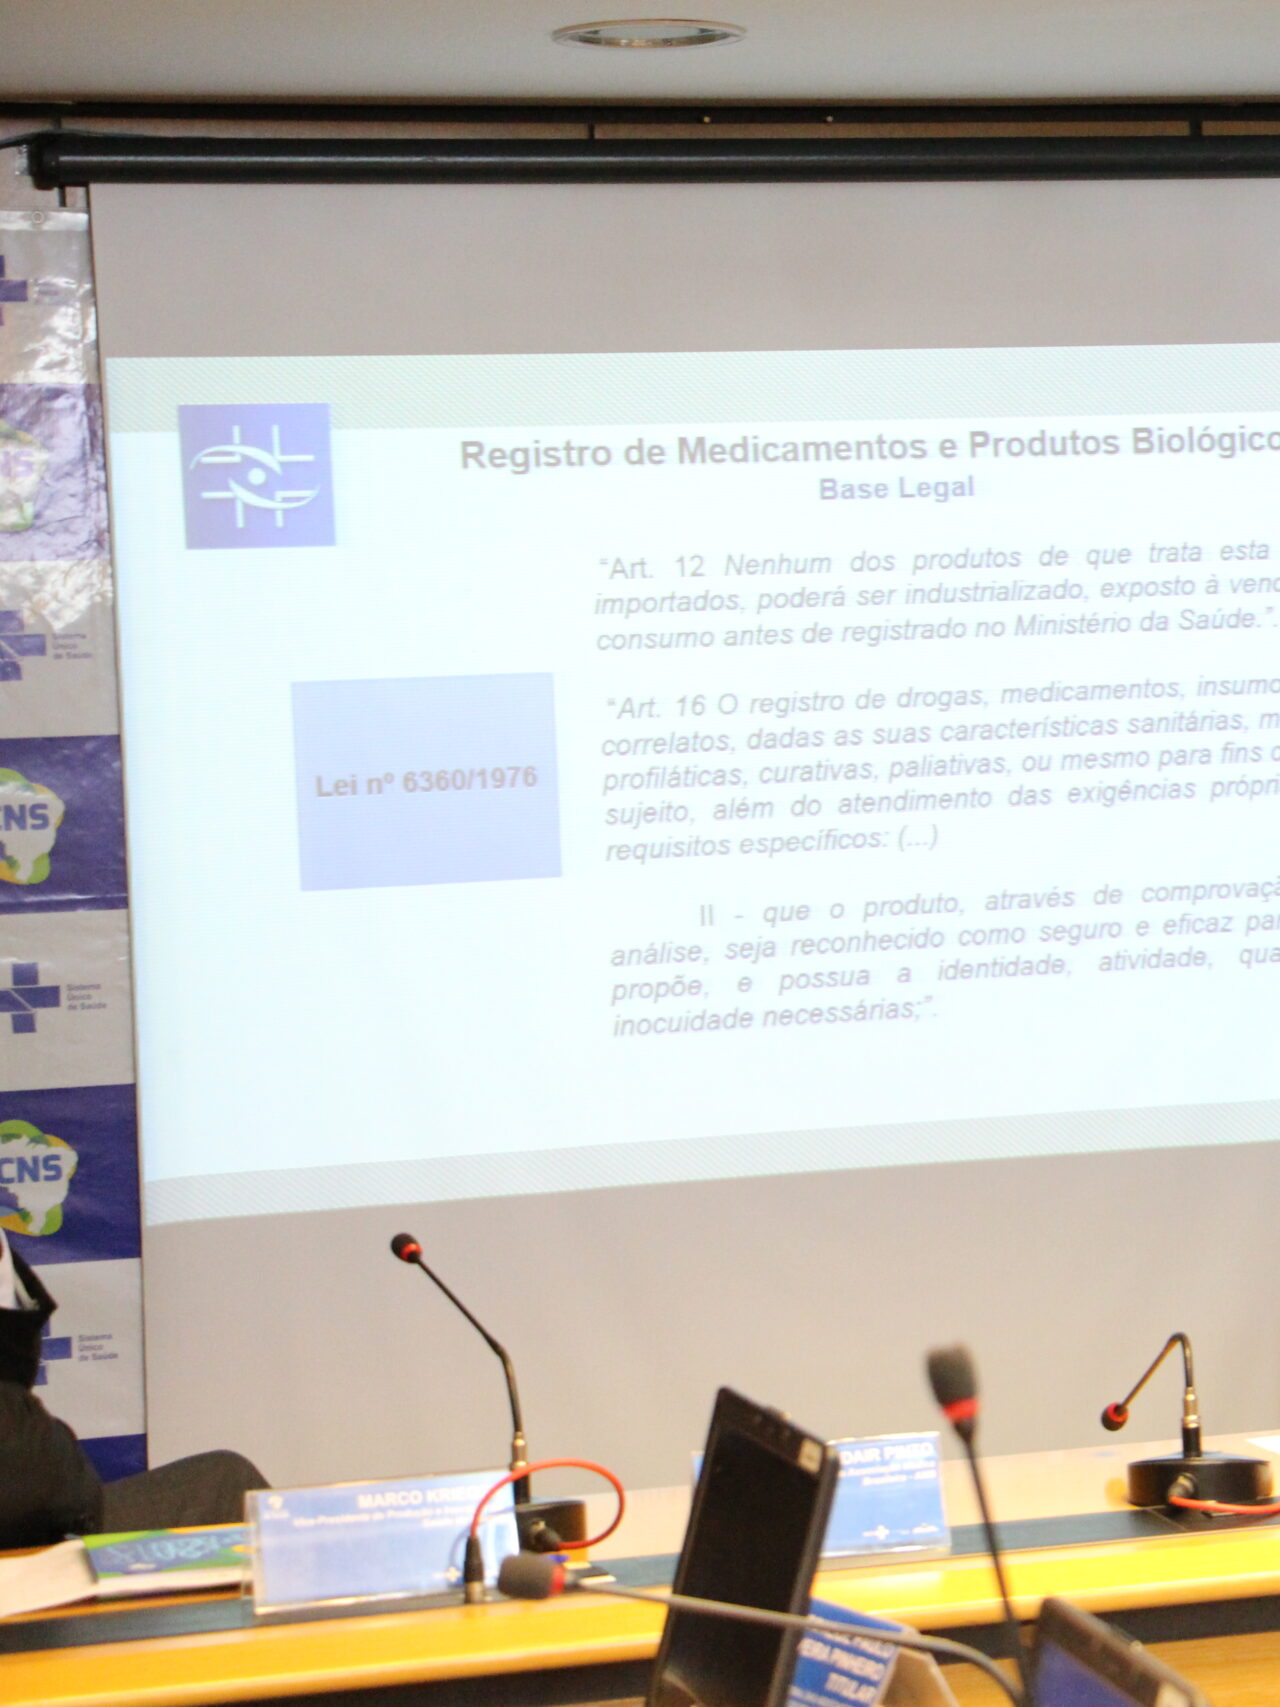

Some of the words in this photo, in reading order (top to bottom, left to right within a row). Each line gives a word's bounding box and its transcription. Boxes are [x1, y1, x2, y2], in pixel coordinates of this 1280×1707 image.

[461, 440, 613, 476] Registro
[624, 437, 666, 467] de
[678, 434, 928, 466] Medicamentos
[939, 438, 958, 460] e
[970, 429, 1121, 459] Produtos
[820, 477, 889, 501] Base
[899, 474, 975, 504] Legal
[675, 553, 706, 578] 12
[724, 553, 833, 577] Nenhum
[849, 549, 897, 573] dos
[911, 546, 1023, 576] produtos
[1038, 544, 1071, 567] de
[1085, 547, 1133, 571] que
[1148, 542, 1204, 564] trata
[1219, 539, 1271, 562] esta
[594, 589, 746, 619] importados,
[756, 585, 847, 615] poderá
[855, 588, 898, 607] ser
[904, 577, 1090, 605] industrializado,
[1099, 575, 1197, 603] exposto
[1204, 574, 1221, 596] à
[596, 631, 716, 651] consumo
[722, 624, 795, 647] antes
[801, 621, 834, 645] de
[841, 616, 968, 649] registrado
[974, 620, 1007, 638] no
[1013, 611, 1133, 637] Ministério
[1138, 610, 1171, 633] da
[676, 693, 707, 718] 16
[717, 692, 740, 716] O
[749, 690, 846, 719] registro
[854, 687, 887, 711] de
[896, 686, 989, 713] drogas,
[1000, 678, 1186, 704] medicamentos,
[601, 731, 737, 757] correlatos,
[746, 726, 826, 751] dadas
[833, 728, 864, 747] as
[872, 726, 932, 746] suas
[939, 715, 1119, 743] características
[1126, 709, 1249, 735] sanitárias,
[315, 773, 359, 798] Lei
[402, 765, 539, 794] 6360/1976
[601, 765, 748, 796] profiláticas,
[758, 758, 879, 785] curativas,
[888, 753, 1012, 784] paliativas,
[1021, 754, 1053, 773] ou
[1060, 750, 1151, 771] mesmo
[1157, 747, 1213, 772] para
[1220, 740, 1264, 765] fins
[604, 800, 695, 830] sujeito,
[712, 795, 775, 822] além
[789, 794, 823, 818] do
[837, 788, 993, 815] atendimento
[1007, 784, 1053, 808] das
[1067, 778, 1197, 809] exigências
[605, 834, 732, 866] requisitos
[699, 904, 715, 927] II
[762, 903, 812, 929] que
[829, 902, 846, 920] o
[862, 892, 965, 923] produto,
[984, 885, 1077, 912] através
[1093, 883, 1125, 906] de
[609, 941, 710, 967] análise,
[724, 935, 778, 965] seja
[790, 926, 946, 957] reconhecido
[957, 926, 1027, 948] como
[1038, 921, 1124, 948] seguro
[1134, 920, 1151, 938] e
[1162, 912, 1234, 937] eficaz
[610, 974, 710, 1007] propõe,
[736, 976, 754, 993] e
[778, 968, 872, 996] possua
[896, 966, 913, 984] a
[937, 953, 1073, 982] identidade,
[1097, 945, 1214, 973] atividade,
[613, 1006, 755, 1037] inocuidade
[0, 1154, 62, 1184] CNS
[357, 1490, 423, 1509] MARCO
